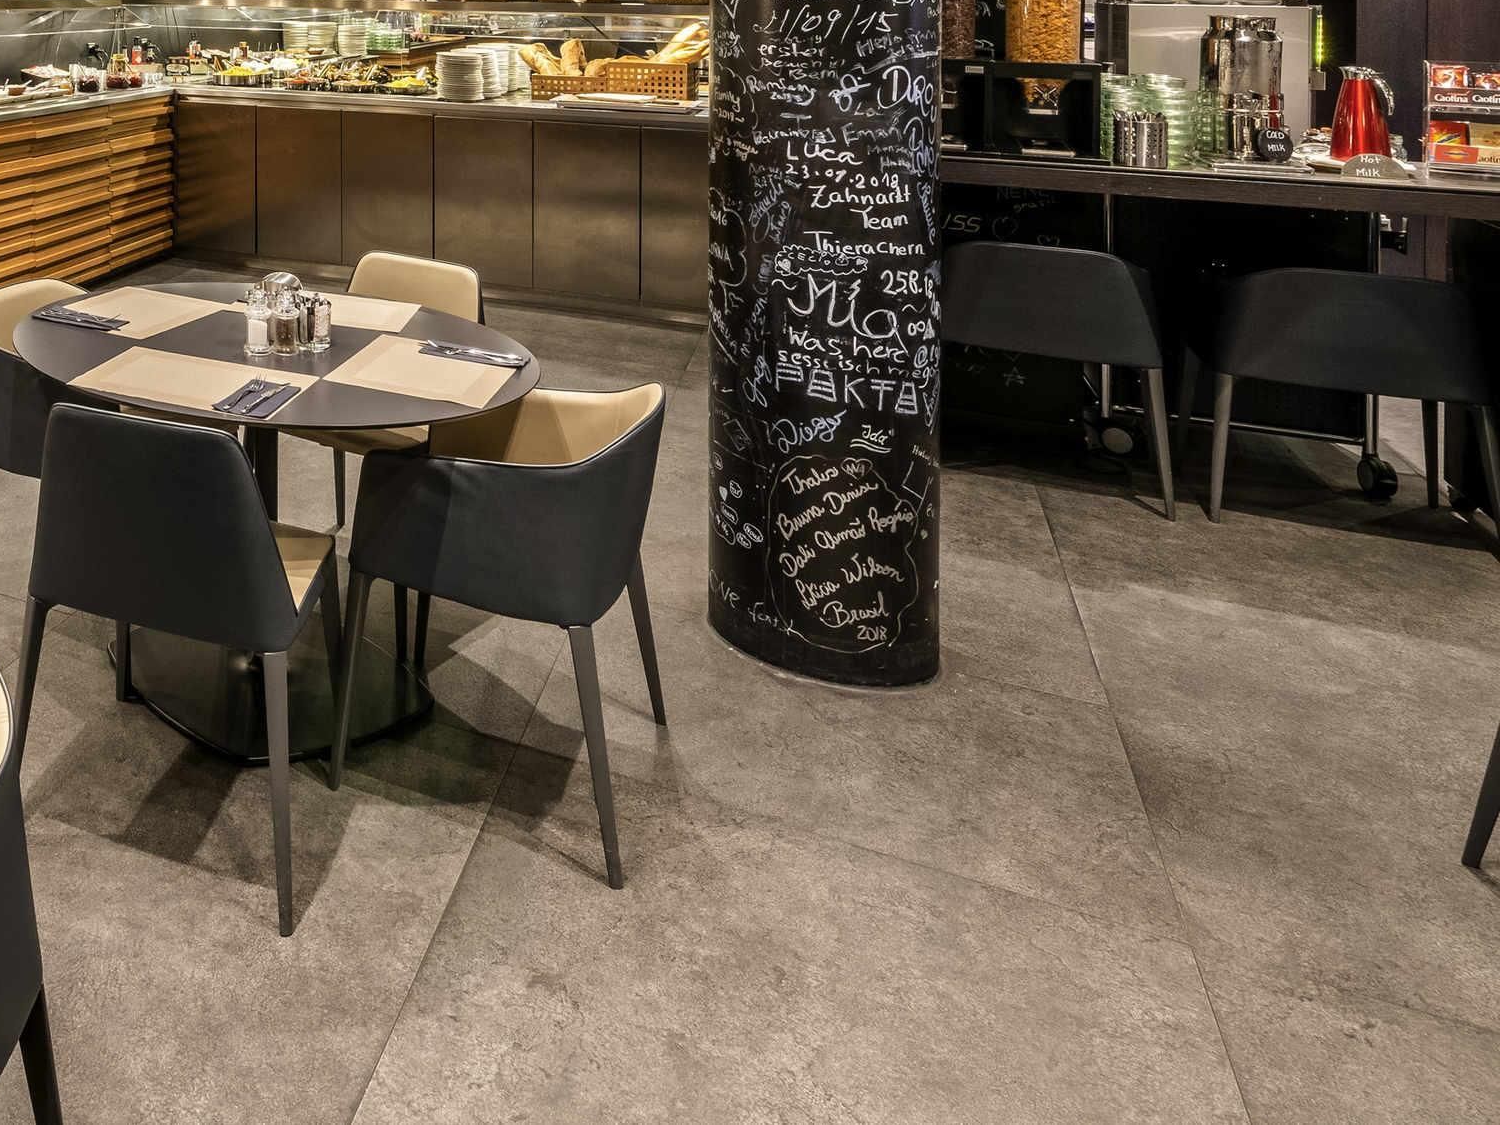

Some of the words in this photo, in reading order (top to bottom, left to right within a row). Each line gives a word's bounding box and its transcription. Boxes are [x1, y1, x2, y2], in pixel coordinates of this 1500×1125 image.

[1434, 92, 1469, 103] Caotina
[1472, 93, 1500, 104] Caotin
[1266, 129, 1285, 140] COLD
[1360, 155, 1382, 164] Hot
[849, 206, 909, 230] Team
[856, 624, 888, 642] 2018
